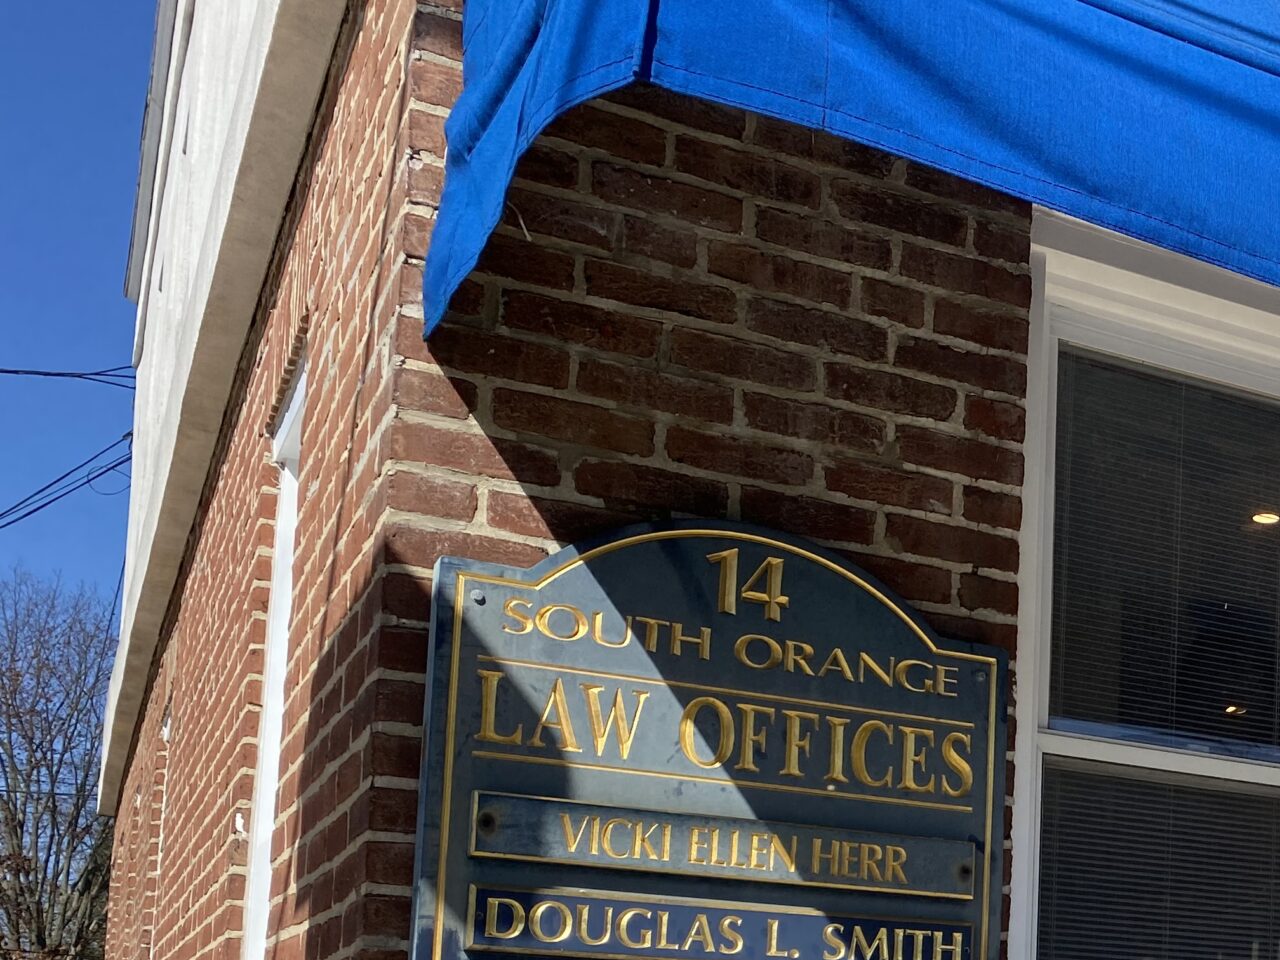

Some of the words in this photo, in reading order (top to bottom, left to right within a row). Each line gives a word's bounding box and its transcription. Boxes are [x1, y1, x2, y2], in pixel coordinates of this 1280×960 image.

[707, 547, 790, 622] 14
[502, 597, 712, 662] SOUTH
[734, 633, 960, 698] ORANGE
[474, 669, 650, 760] LAW
[679, 696, 975, 798] OFFICES
[560, 813, 672, 862] VICKI
[688, 825, 797, 873] ELLEN
[812, 838, 908, 884] HERR
[484, 897, 744, 955] DOUGLAS
[766, 918, 800, 959] L.
